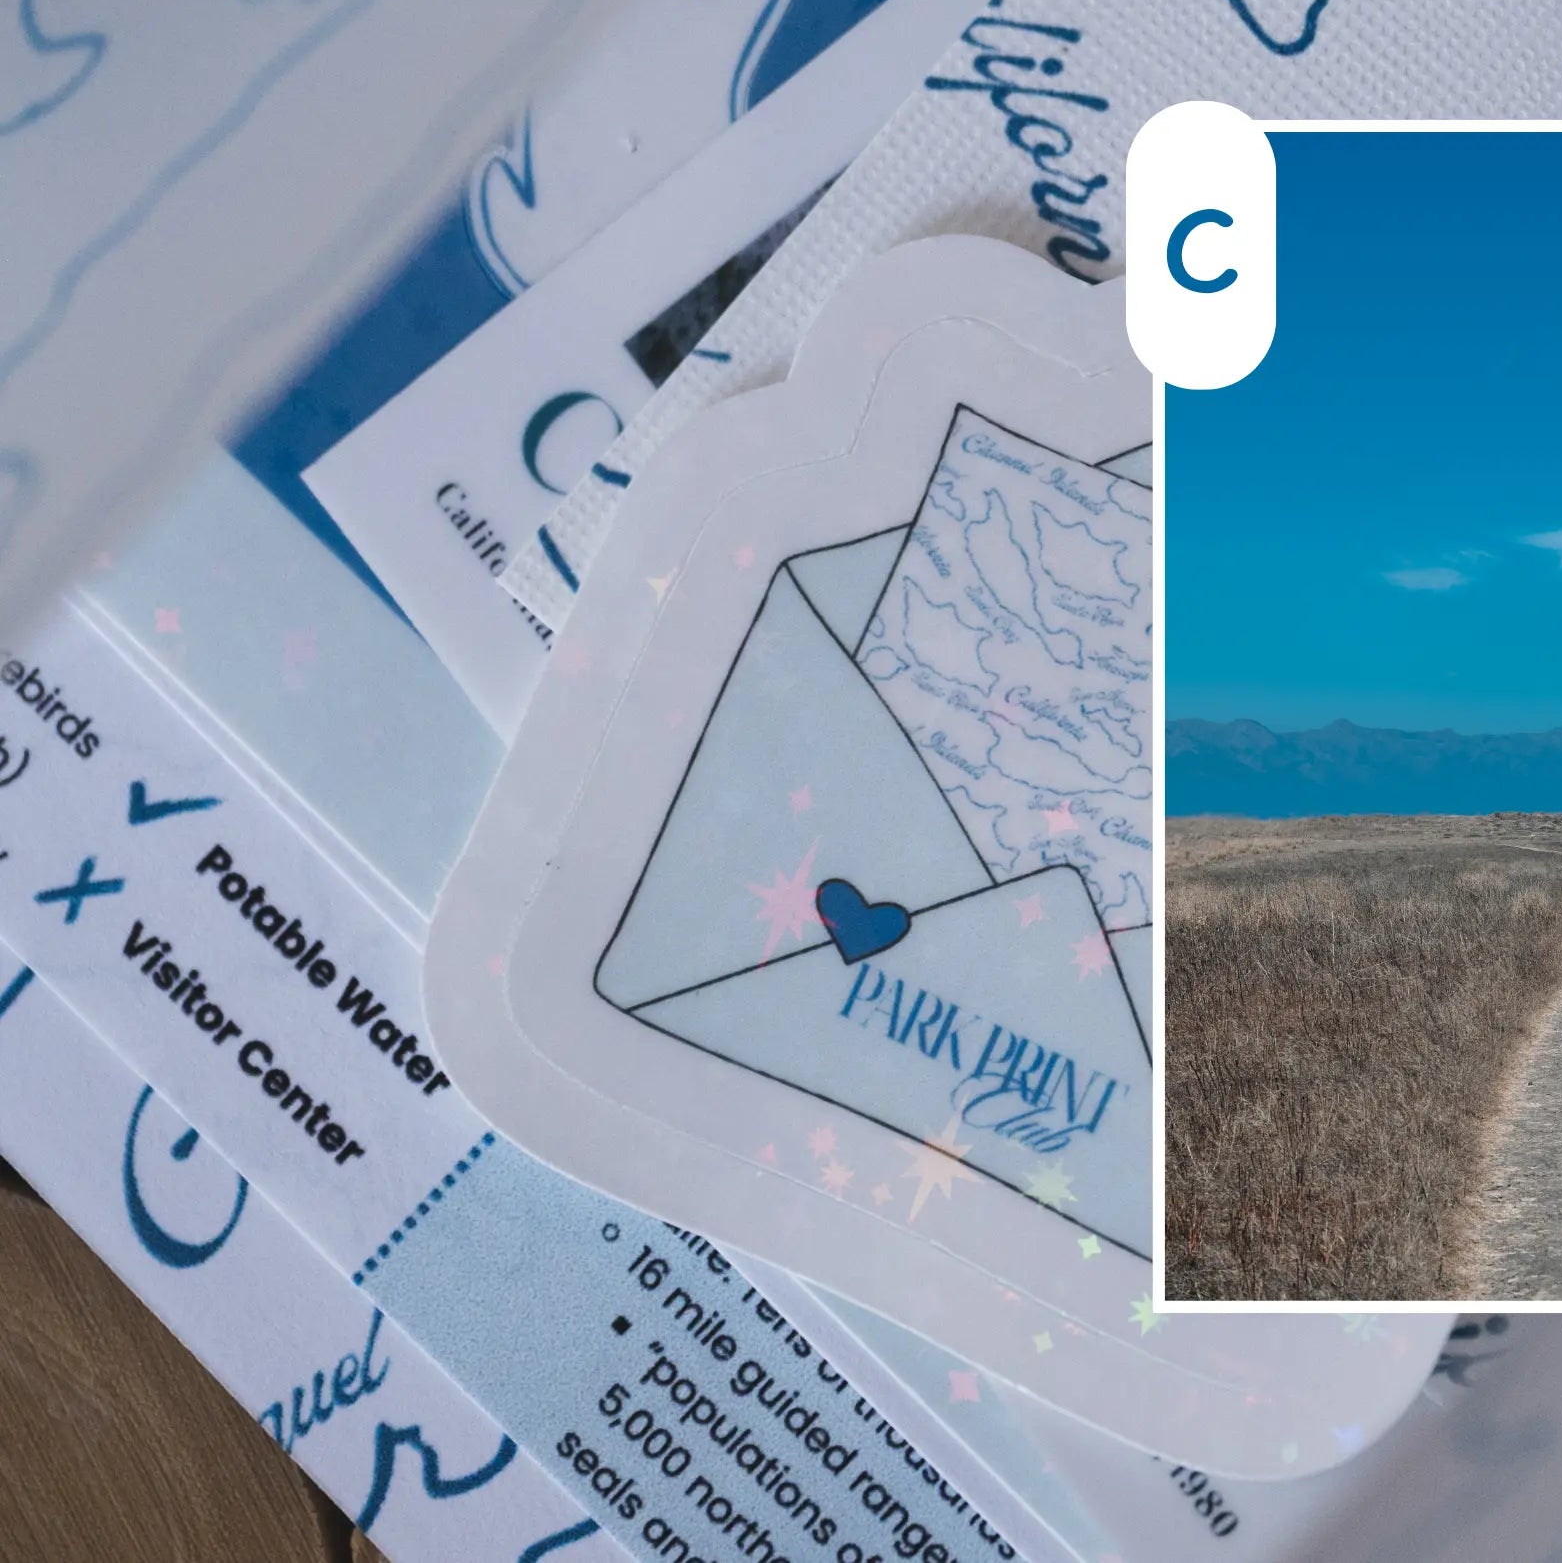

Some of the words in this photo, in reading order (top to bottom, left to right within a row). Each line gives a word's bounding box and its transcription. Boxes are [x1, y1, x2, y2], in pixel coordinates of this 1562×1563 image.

[0, 659, 101, 760] ebirds
[122, 920, 243, 1046] Visitor
[238, 1039, 365, 1166] Center
[196, 844, 337, 990] Potable
[336, 976, 452, 1097] Water
[840, 962, 982, 1071] PARK
[971, 1023, 1131, 1134] PRINT
[556, 1432, 644, 1521] seals
[598, 1383, 692, 1478] 5,000
[684, 1474, 791, 1563] north
[627, 1244, 671, 1291] 16
[662, 1286, 738, 1362] mile
[729, 1359, 860, 1477] guided
[848, 1469, 969, 1563] range
